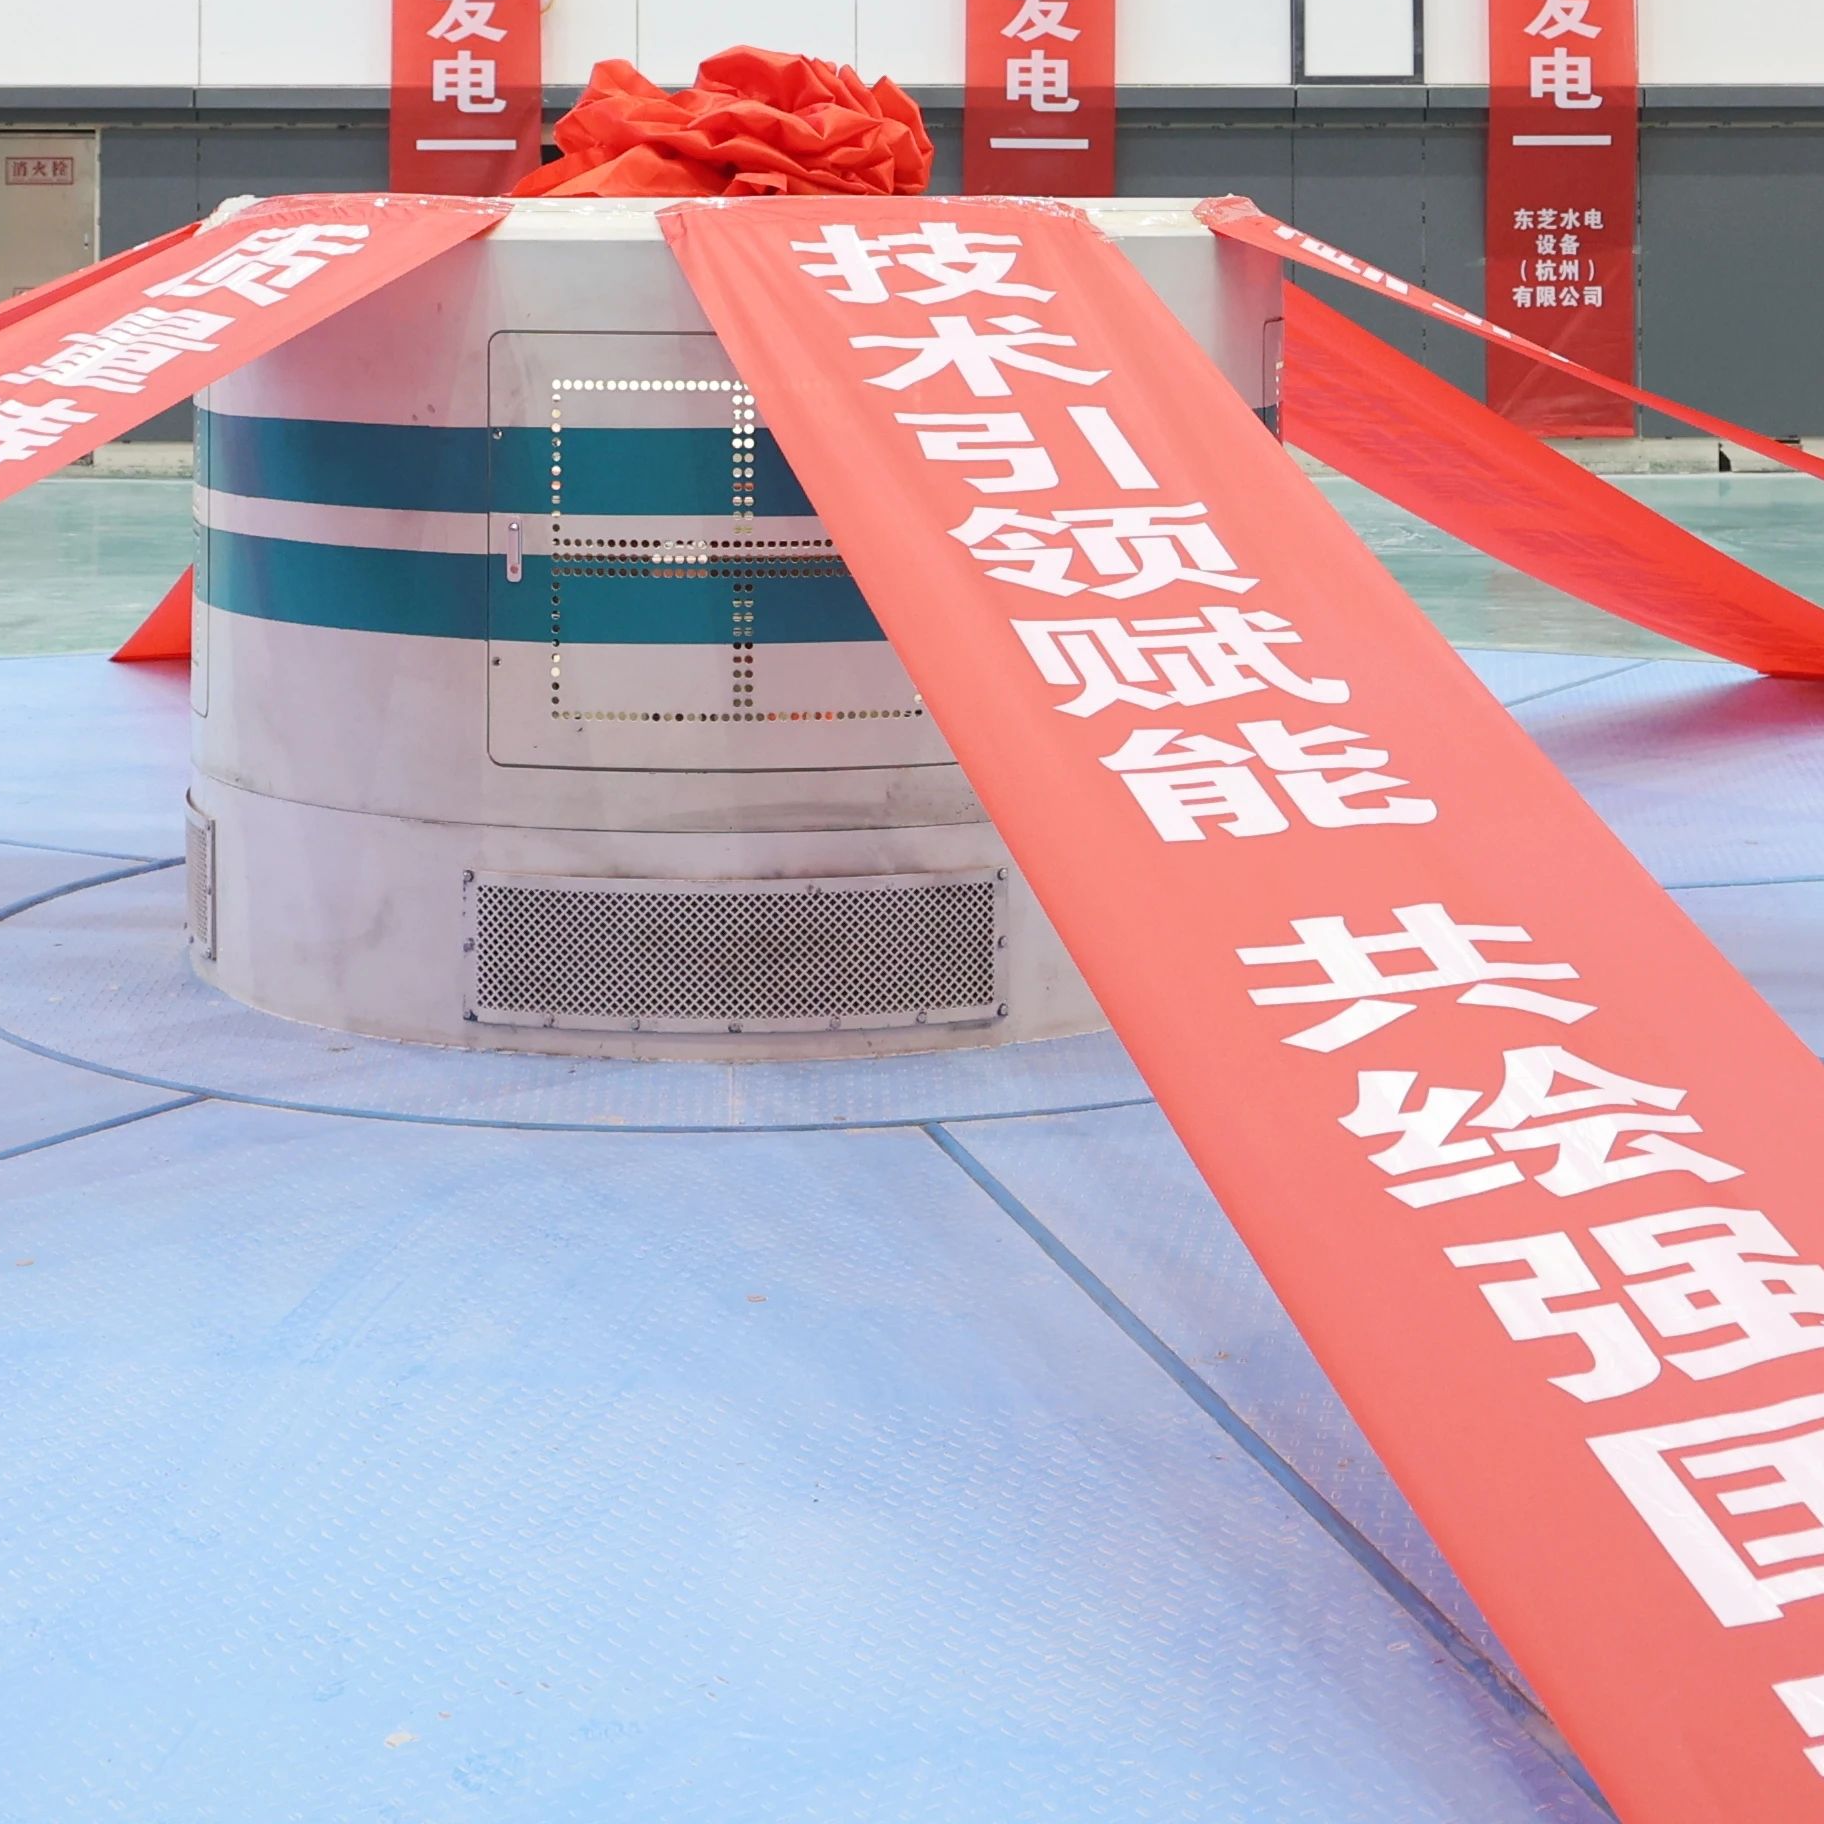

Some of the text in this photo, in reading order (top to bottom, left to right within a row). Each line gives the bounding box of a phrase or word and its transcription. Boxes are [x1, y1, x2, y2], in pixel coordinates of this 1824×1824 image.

[12, 161, 68, 177] 消火栓
[1514, 208, 1603, 230] 东芝水电
[1536, 234, 1580, 255] 设备
[1512, 286, 1602, 307] 有限公司
[790, 222, 1436, 841] 技术引领赋能
